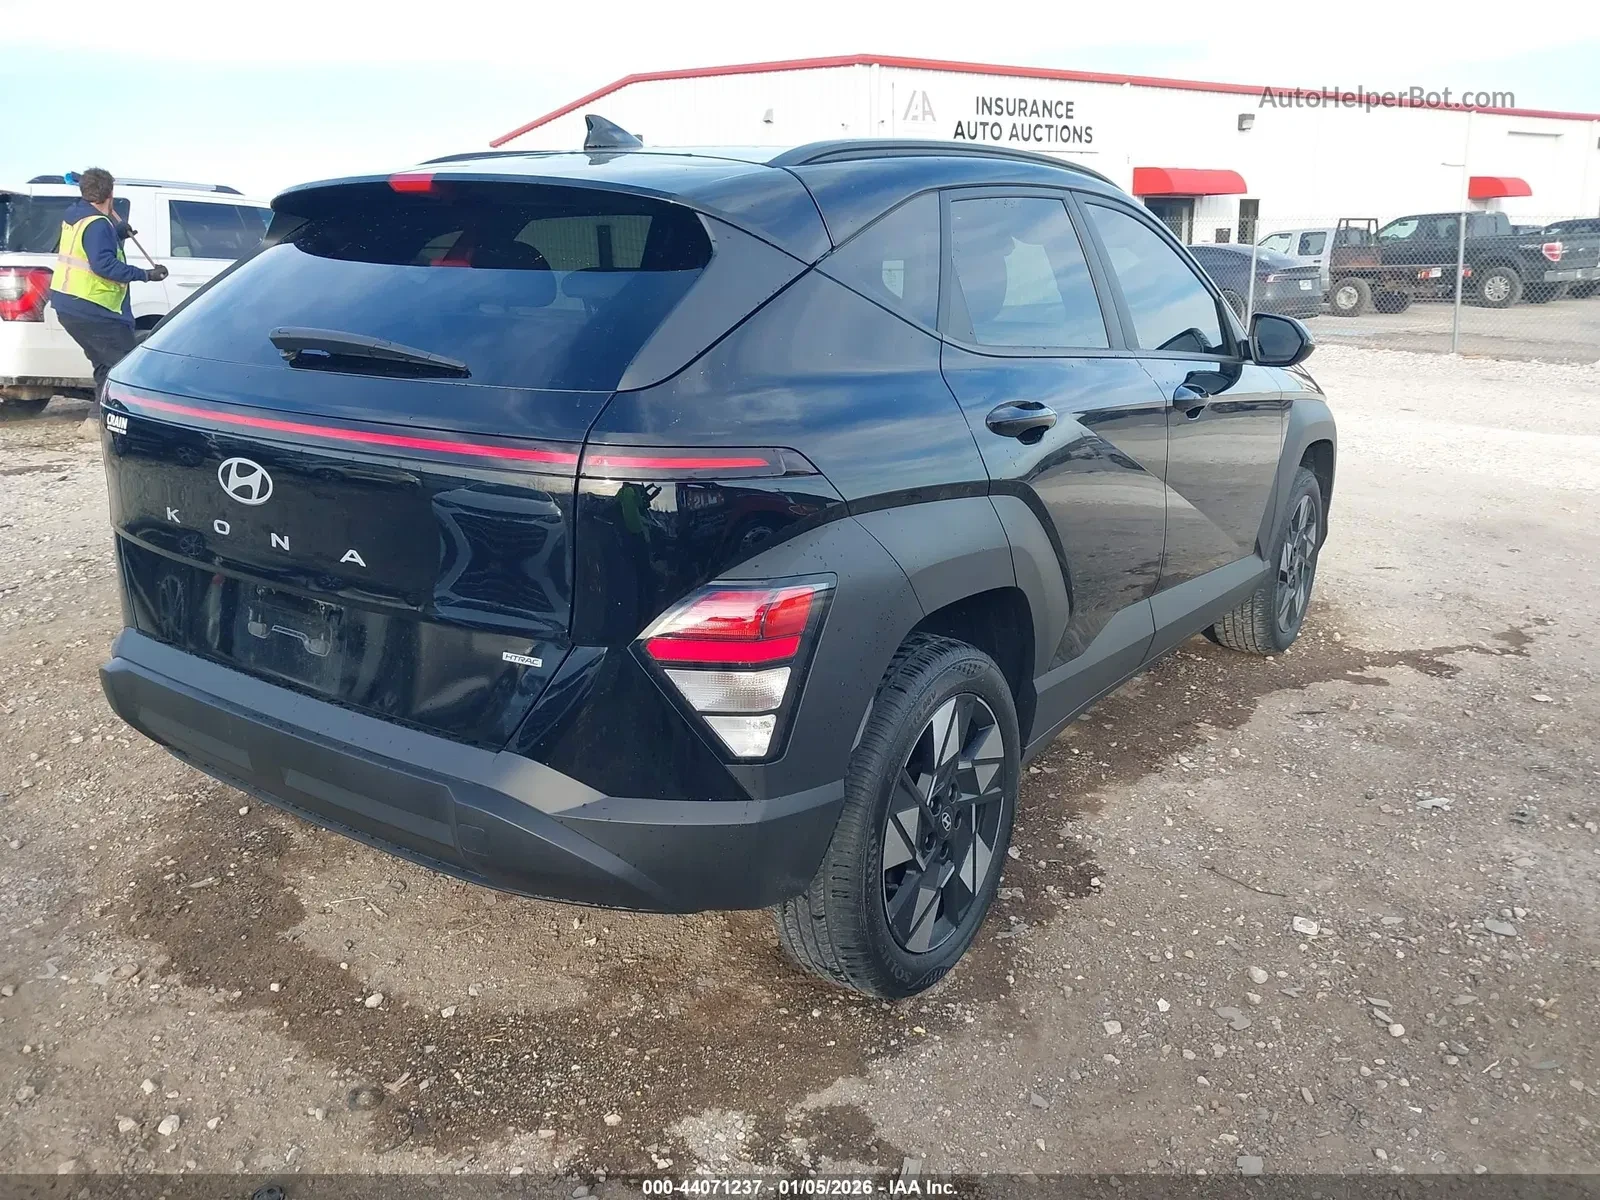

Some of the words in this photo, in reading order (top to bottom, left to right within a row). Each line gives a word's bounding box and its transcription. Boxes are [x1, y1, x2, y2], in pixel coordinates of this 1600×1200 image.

[976, 96, 1074, 119] INSURANCE
[953, 121, 1003, 141] AUTO
[1008, 122, 1093, 144] AUCTIONS
[106, 412, 128, 430] CRAIN
[166, 506, 366, 567] KONA
[504, 653, 540, 666] HTRAC
